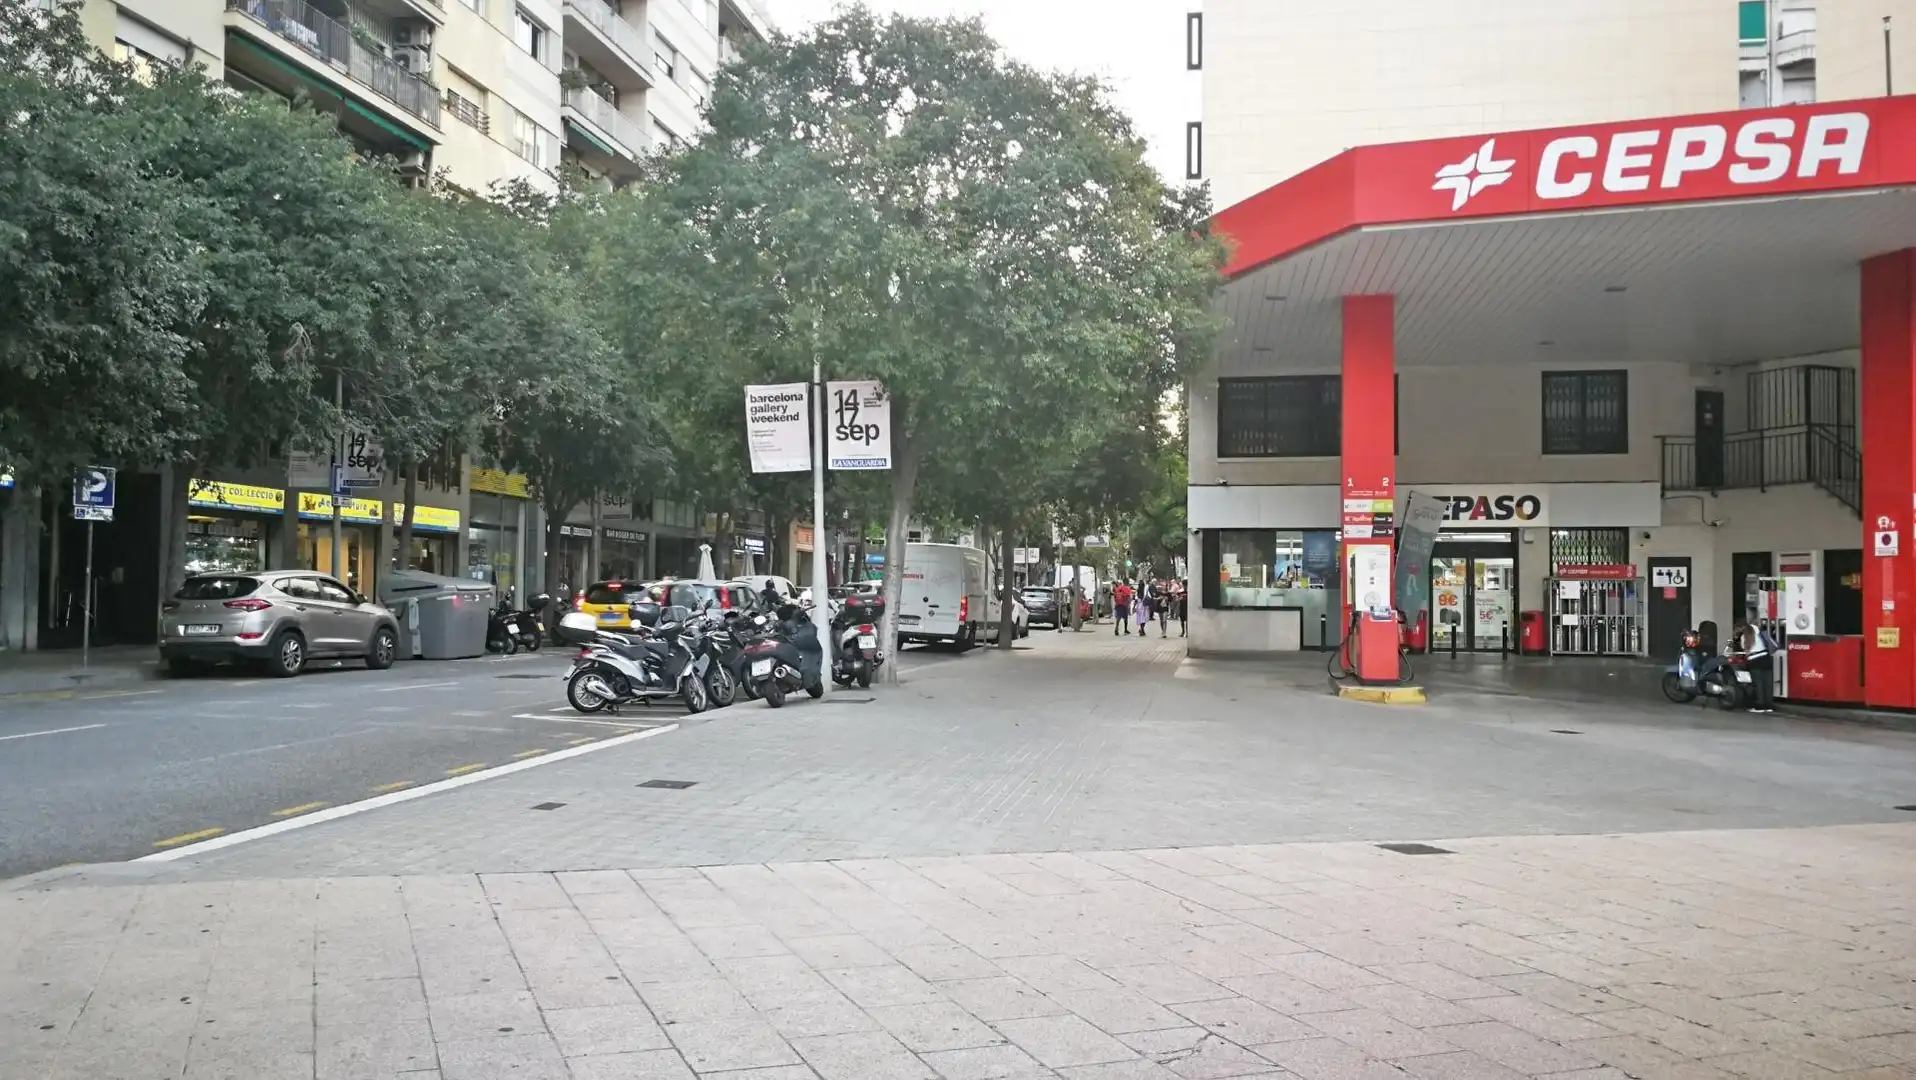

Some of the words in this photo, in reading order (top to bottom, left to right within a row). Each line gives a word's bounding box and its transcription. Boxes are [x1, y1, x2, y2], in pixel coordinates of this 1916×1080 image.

[1535, 111, 1870, 200] CEPSA
[750, 392, 804, 404] barcelona
[834, 388, 860, 407] 14
[750, 403, 788, 415] gallery
[750, 411, 800, 424] weekend
[835, 405, 859, 428] 17
[835, 423, 880, 446] sep
[1347, 477, 1354, 487] 1
[1382, 476, 1389, 487] 2
